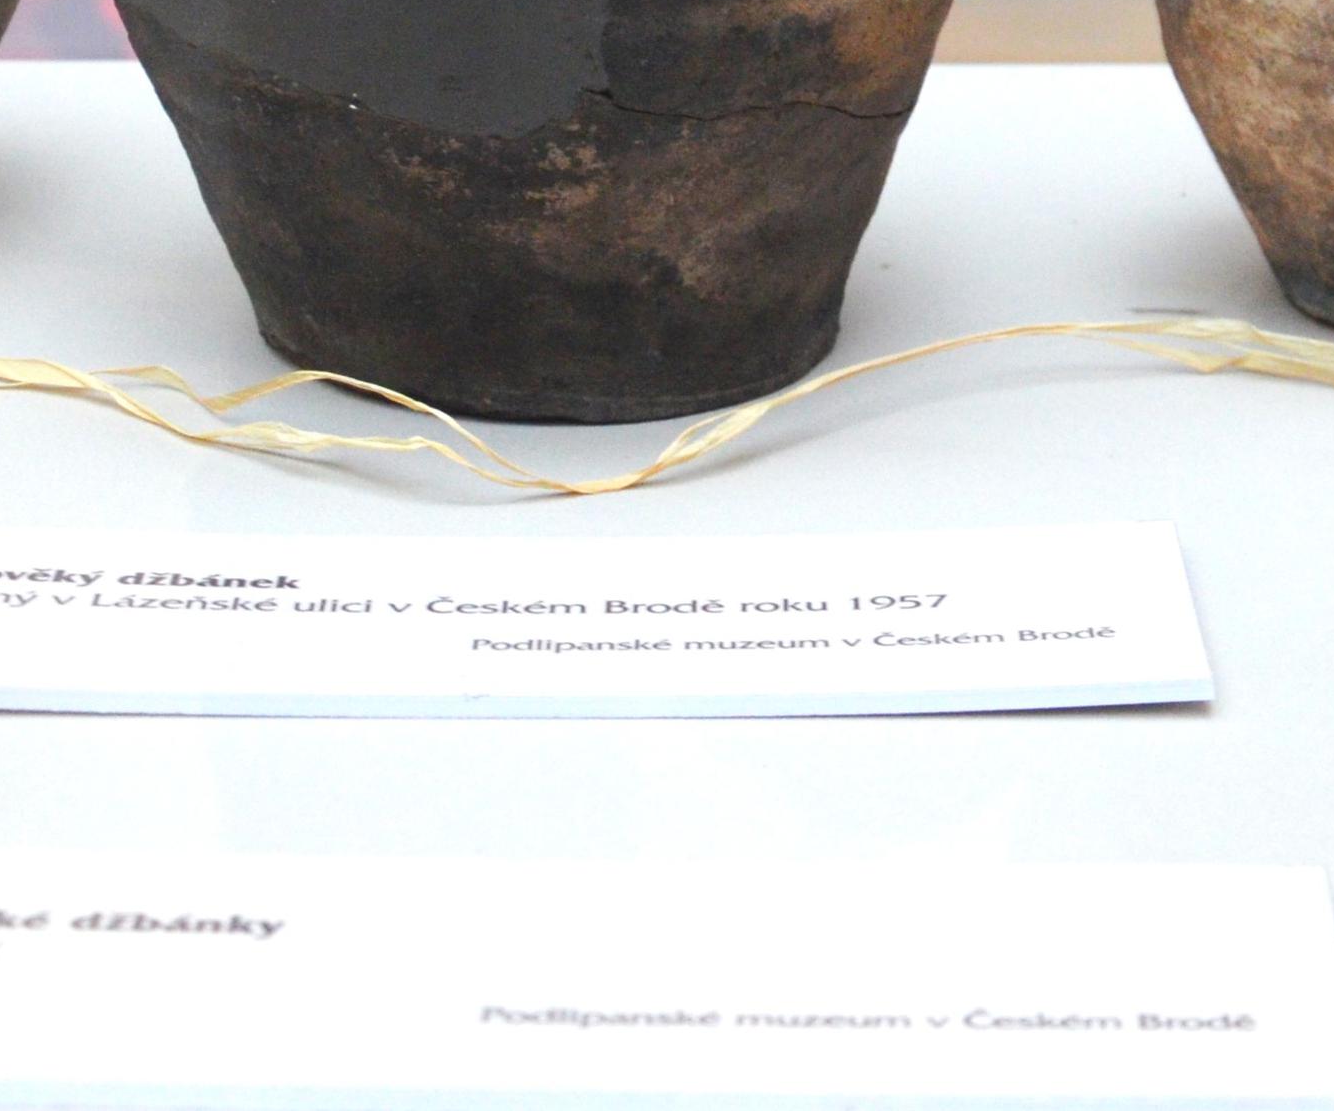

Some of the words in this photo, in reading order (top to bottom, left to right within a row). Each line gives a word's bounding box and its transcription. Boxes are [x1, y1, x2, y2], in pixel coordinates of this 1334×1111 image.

[116, 571, 301, 591] džbánek
[52, 594, 76, 606] v
[90, 591, 279, 613] Lázeňské
[293, 597, 373, 614] ulici
[387, 602, 412, 614] v
[424, 595, 587, 615] Českém
[603, 598, 726, 615] Brodě
[739, 596, 829, 613] roku
[849, 592, 949, 611] 1957
[470, 637, 673, 656] Podlipanské
[683, 639, 831, 652] muzeum
[841, 637, 862, 648] v
[871, 630, 1006, 648] Českém
[1017, 625, 1117, 643] Brodě
[68, 910, 287, 941] džbánky
[478, 1004, 722, 1030] Podlipanské
[733, 1012, 913, 1030] muzeum
[925, 1014, 951, 1029] v
[961, 1006, 1124, 1031] Českém
[1135, 1011, 1257, 1032] Brodě
